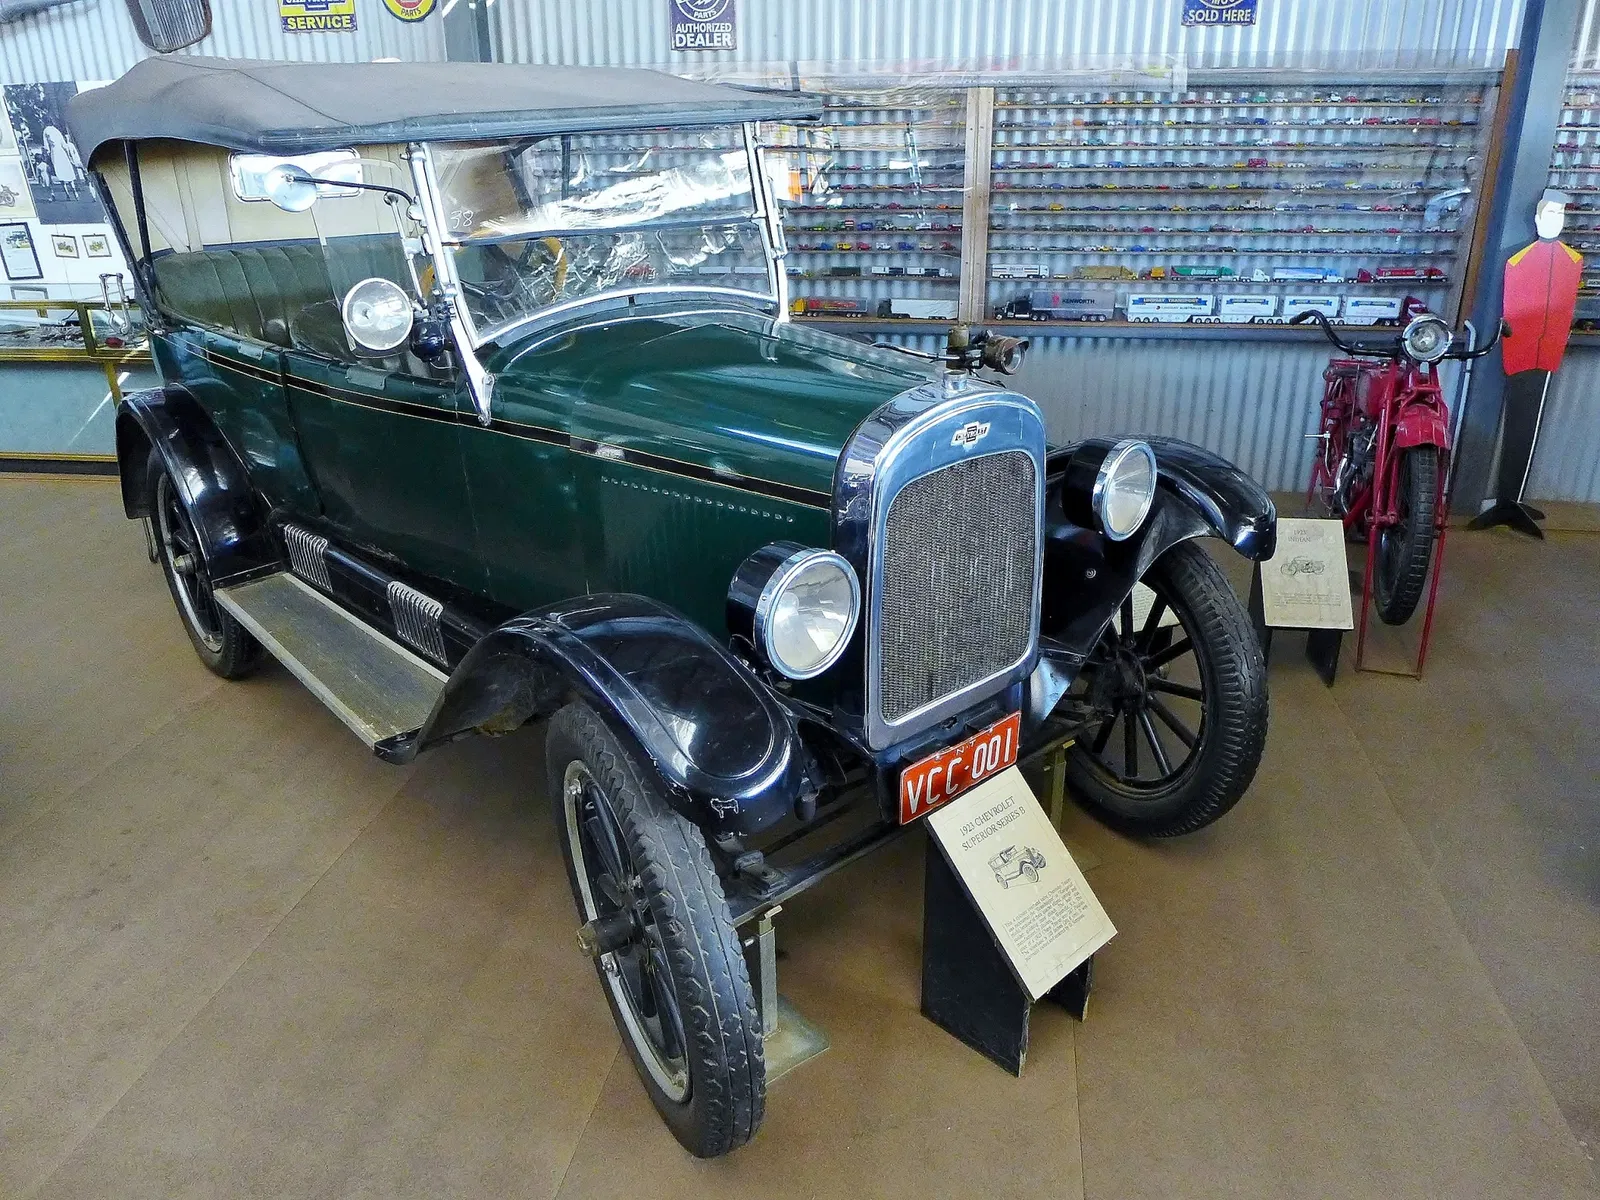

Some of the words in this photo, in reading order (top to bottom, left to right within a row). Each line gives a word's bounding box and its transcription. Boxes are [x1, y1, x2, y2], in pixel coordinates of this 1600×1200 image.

[401, 8, 422, 16] PARTS
[694, 9, 717, 18] PARTS
[1188, 9, 1219, 22] SOLD
[1222, 9, 1251, 21] HERE
[287, 16, 352, 30] SERVICE
[676, 23, 732, 33] AUTHORIZED
[676, 33, 732, 47] DEALER
[450, 210, 474, 229] 38
[959, 822, 975, 836] 1923
[974, 796, 1016, 827] CHEVROLET
[961, 823, 998, 852] SUPERIOR
[996, 809, 1021, 829] SERIES
[1019, 806, 1026, 815] B
